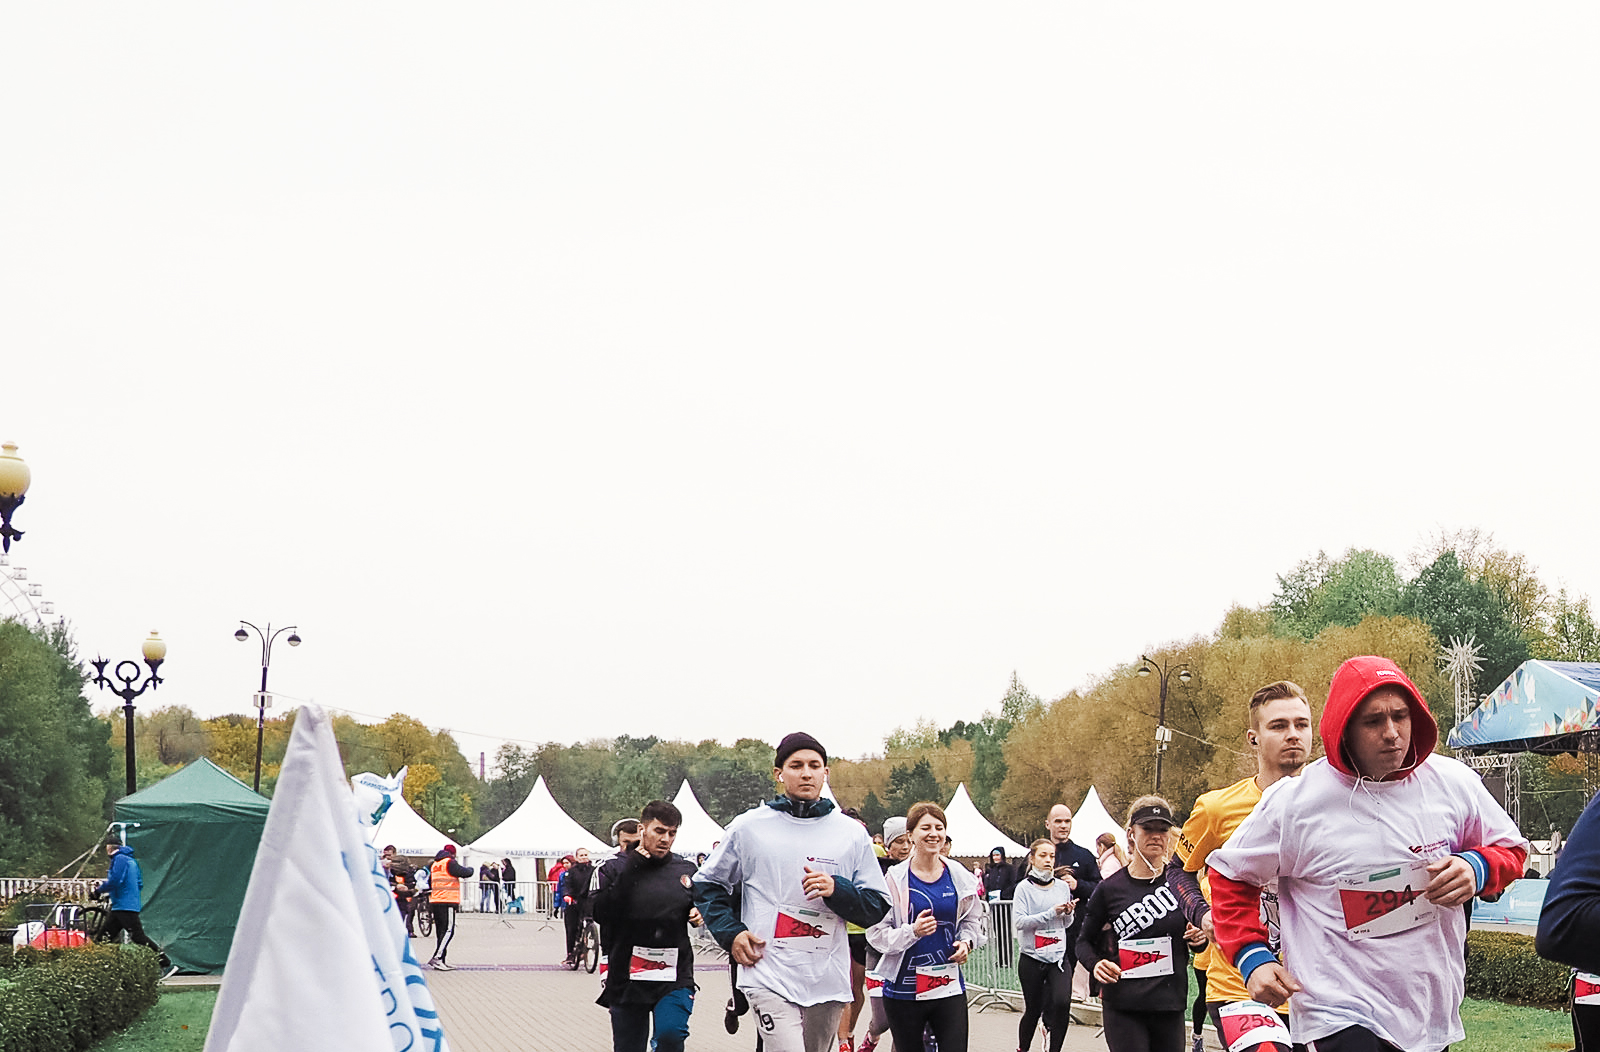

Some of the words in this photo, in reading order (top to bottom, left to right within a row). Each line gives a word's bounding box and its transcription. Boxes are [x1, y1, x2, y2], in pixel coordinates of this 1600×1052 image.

[1364, 884, 1416, 916] 294
[790, 920, 823, 939] 296
[1133, 950, 1161, 965] 297
